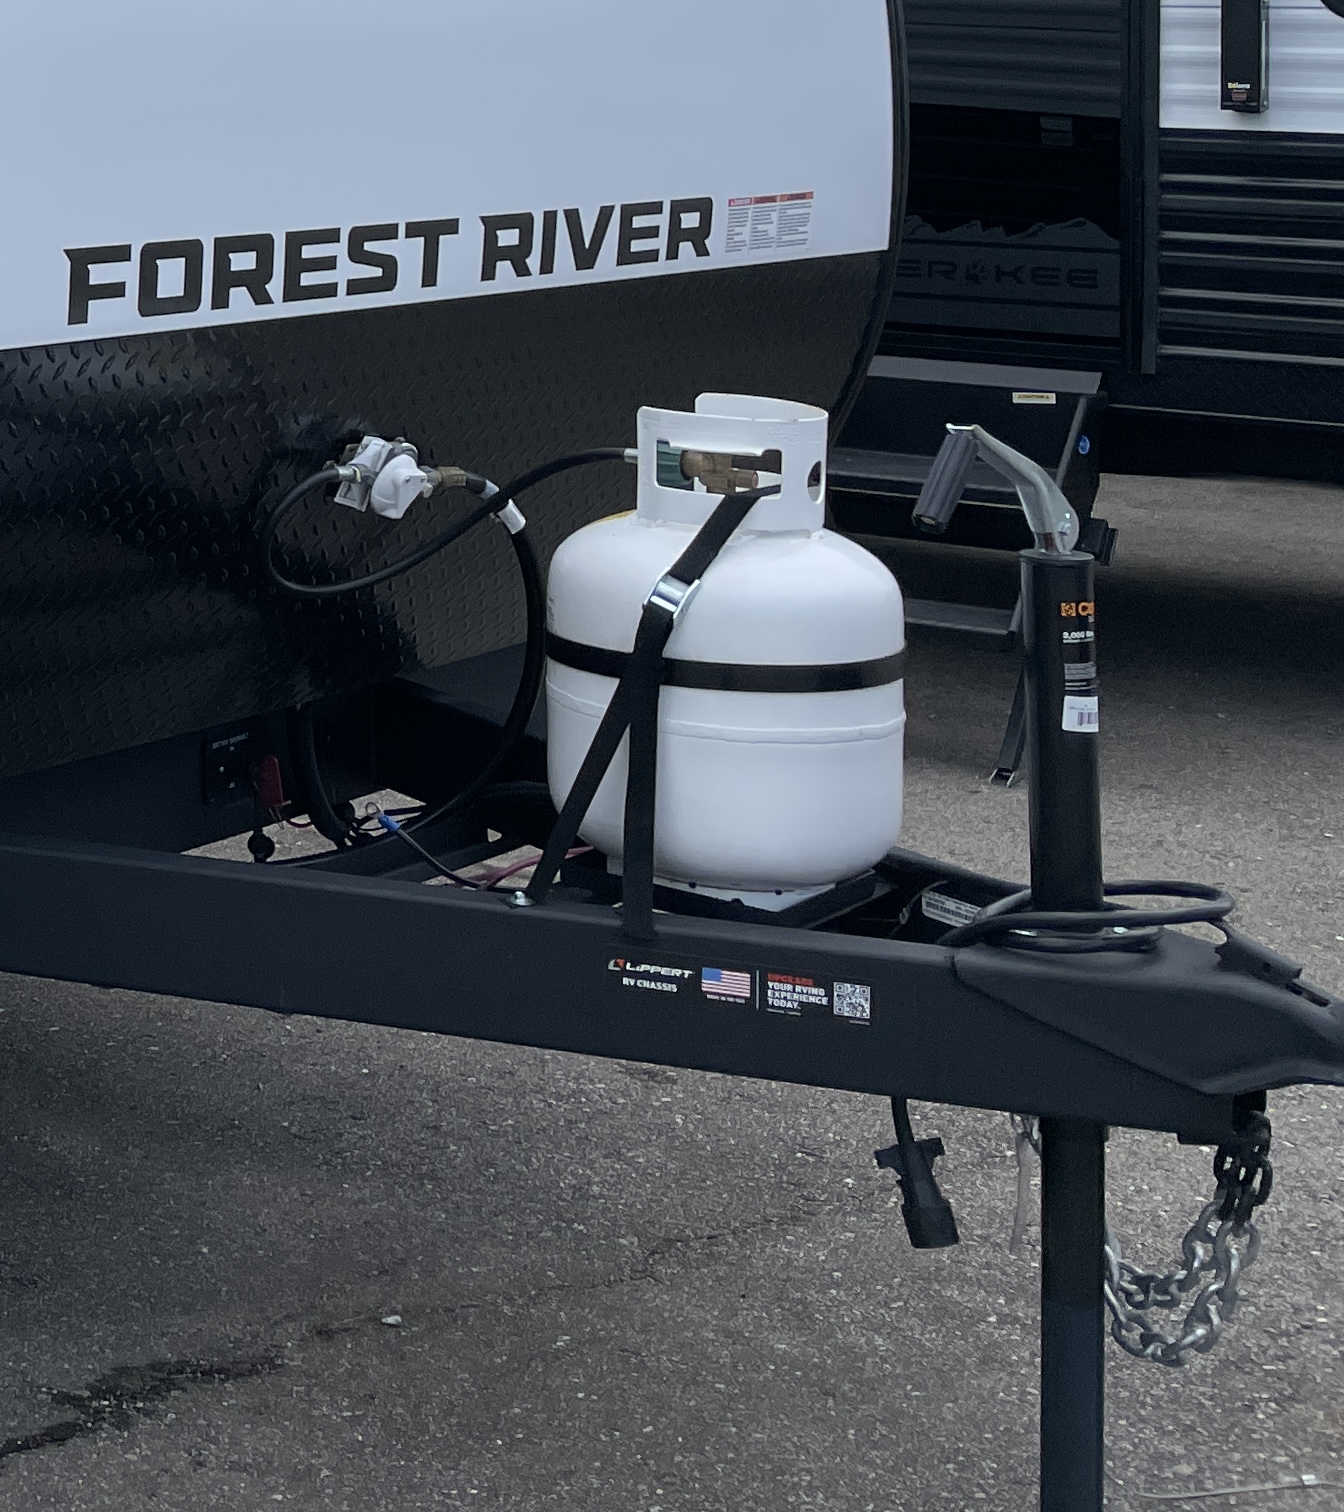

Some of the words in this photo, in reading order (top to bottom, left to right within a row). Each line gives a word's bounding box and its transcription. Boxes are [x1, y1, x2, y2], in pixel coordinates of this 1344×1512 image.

[63, 217, 459, 325] FOREST
[479, 196, 714, 282] RIVER
[622, 977, 635, 986] RV
[636, 979, 678, 993] CHASSIS
[767, 981, 794, 992] YOUR
[767, 989, 830, 1005] EXPERIENCE
